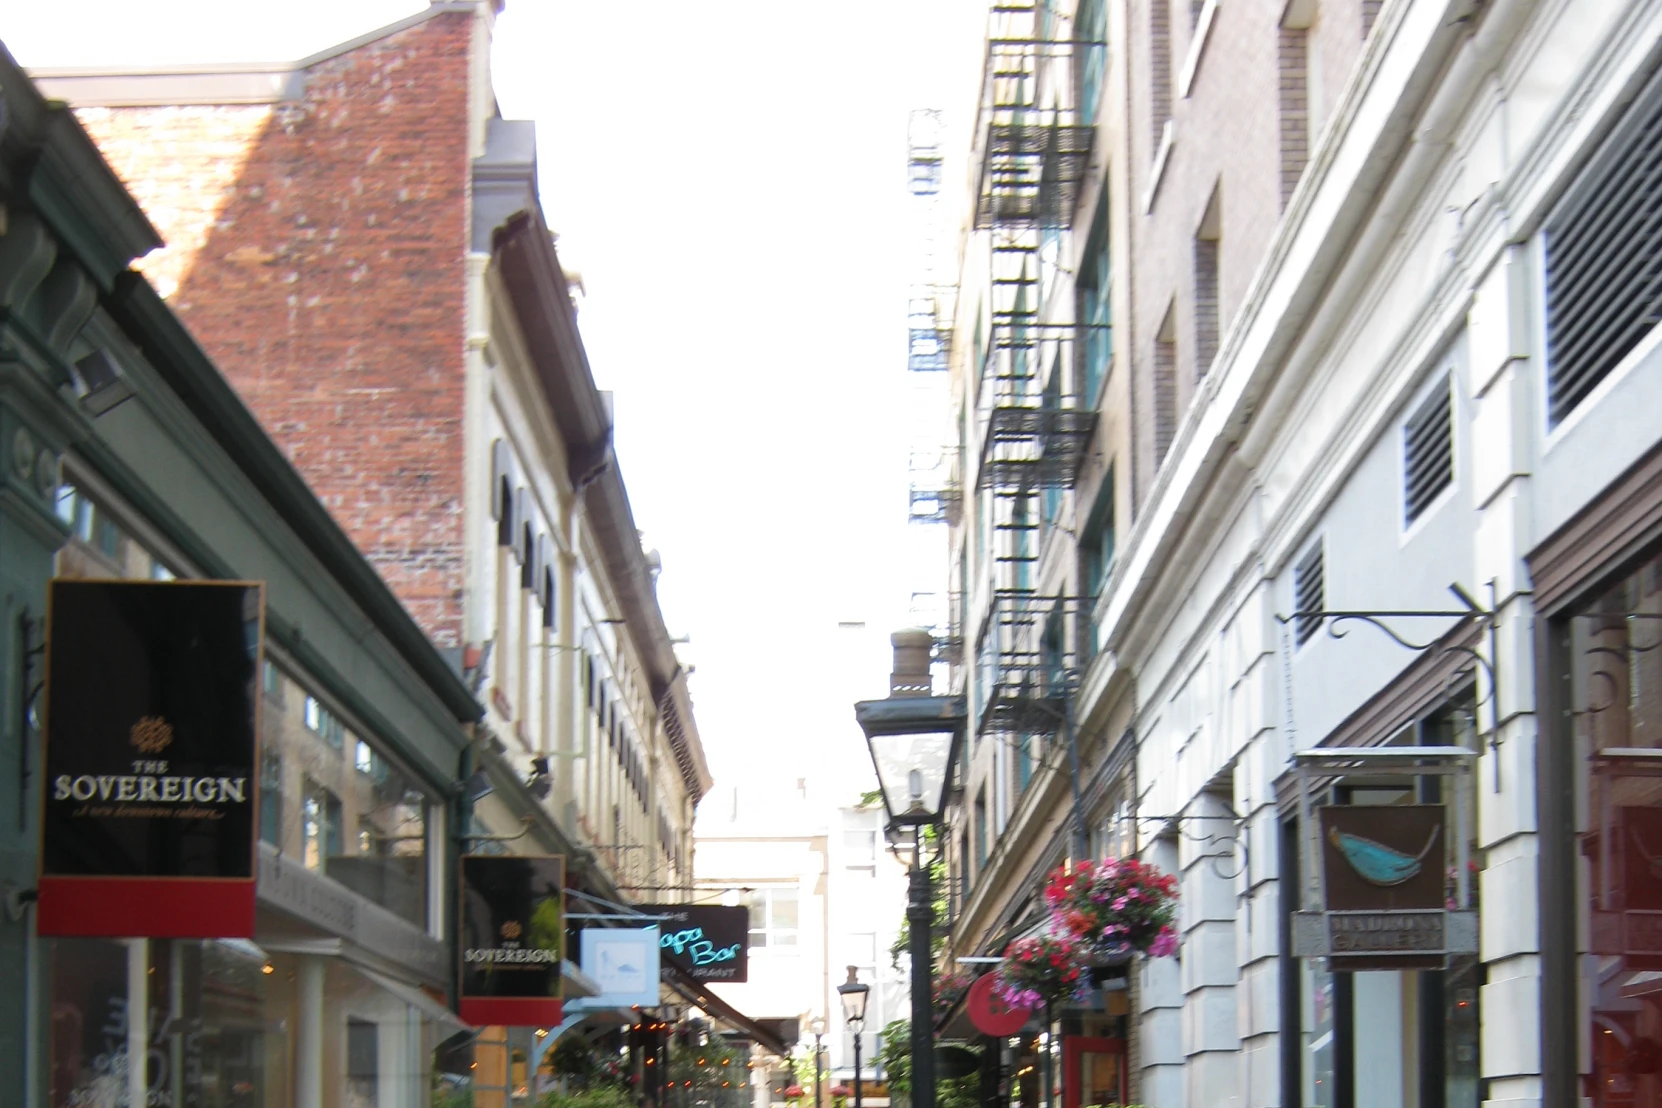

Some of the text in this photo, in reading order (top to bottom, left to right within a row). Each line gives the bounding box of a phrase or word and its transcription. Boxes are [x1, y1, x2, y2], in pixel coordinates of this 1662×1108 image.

[131, 759, 170, 774] THE
[54, 774, 247, 803] SOVEREIGN
[660, 926, 703, 956] apa
[1331, 934, 1442, 950] GALLERY
[464, 948, 558, 963] SOVEREIGN
[689, 939, 742, 966] Bar
